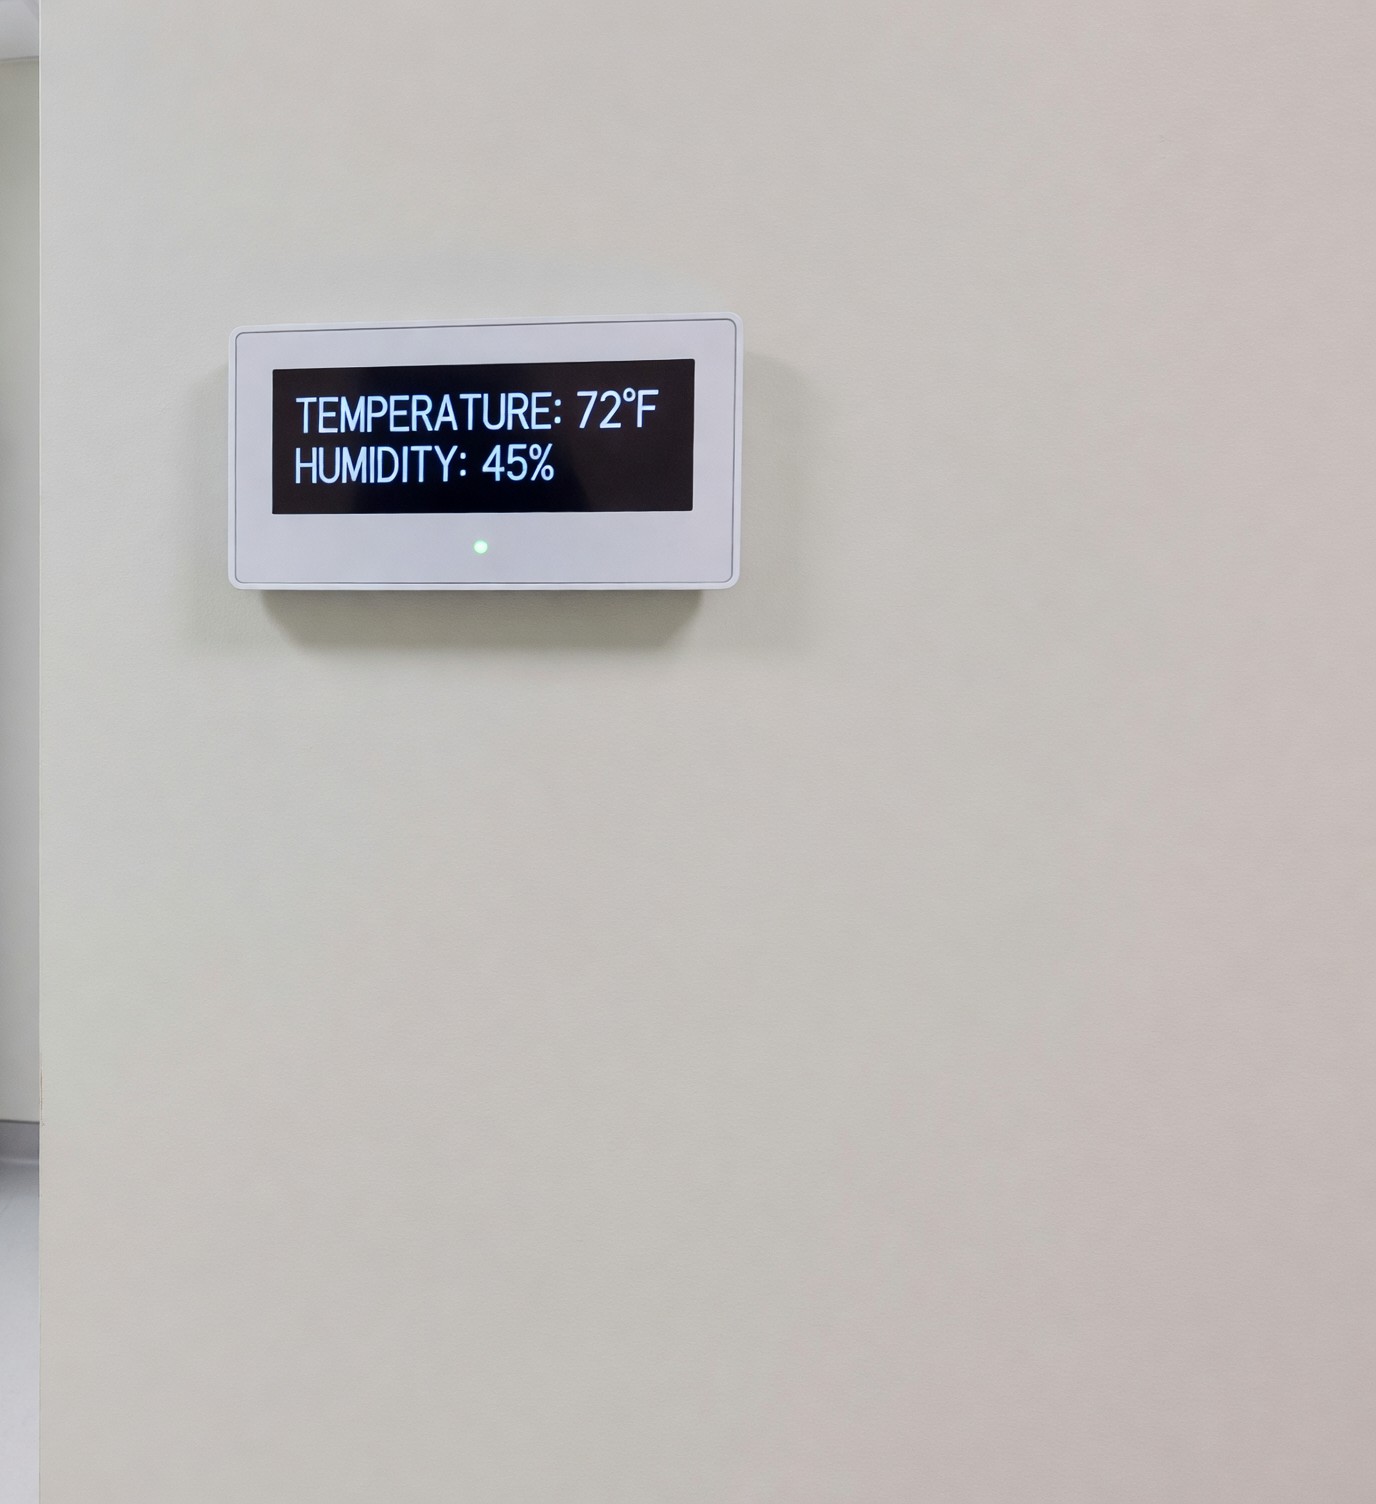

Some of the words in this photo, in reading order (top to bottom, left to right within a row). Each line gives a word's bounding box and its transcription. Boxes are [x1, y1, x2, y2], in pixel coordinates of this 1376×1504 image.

[295, 391, 562, 434] TEMPERATURE:
[576, 387, 660, 429] 72°F
[295, 444, 467, 484] HUMIDITY:
[481, 443, 555, 482] 45%
